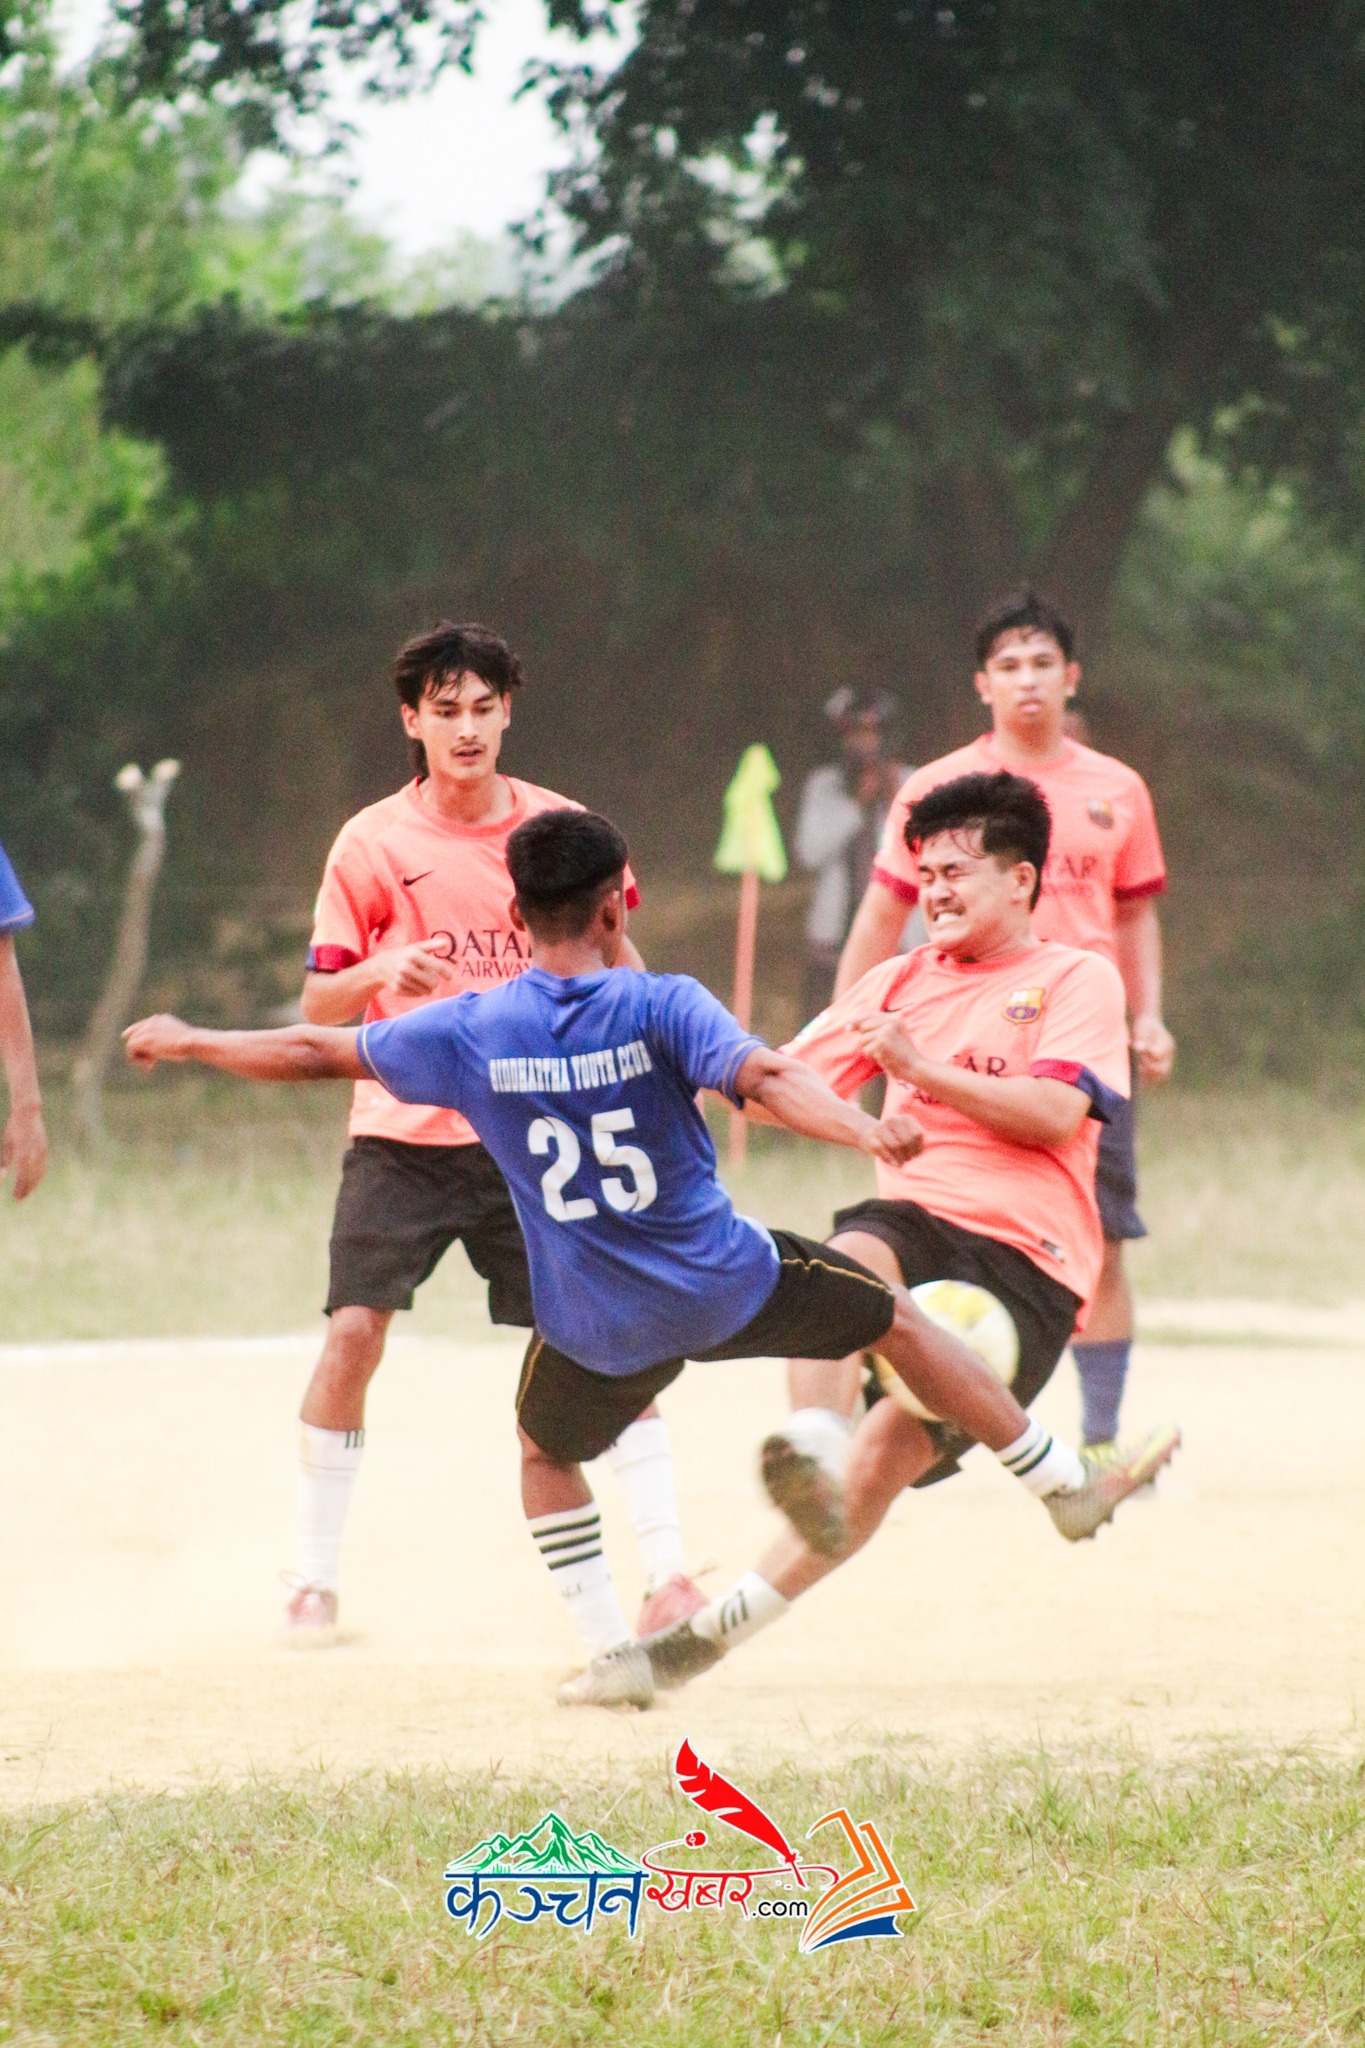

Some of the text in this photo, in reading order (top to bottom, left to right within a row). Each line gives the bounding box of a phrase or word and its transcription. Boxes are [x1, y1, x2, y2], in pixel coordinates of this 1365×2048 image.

[461, 960, 531, 979] AIRWA
[570, 1048, 618, 1091] YOUTH
[616, 1039, 653, 1081] CLUB
[527, 1106, 658, 1222] 25
